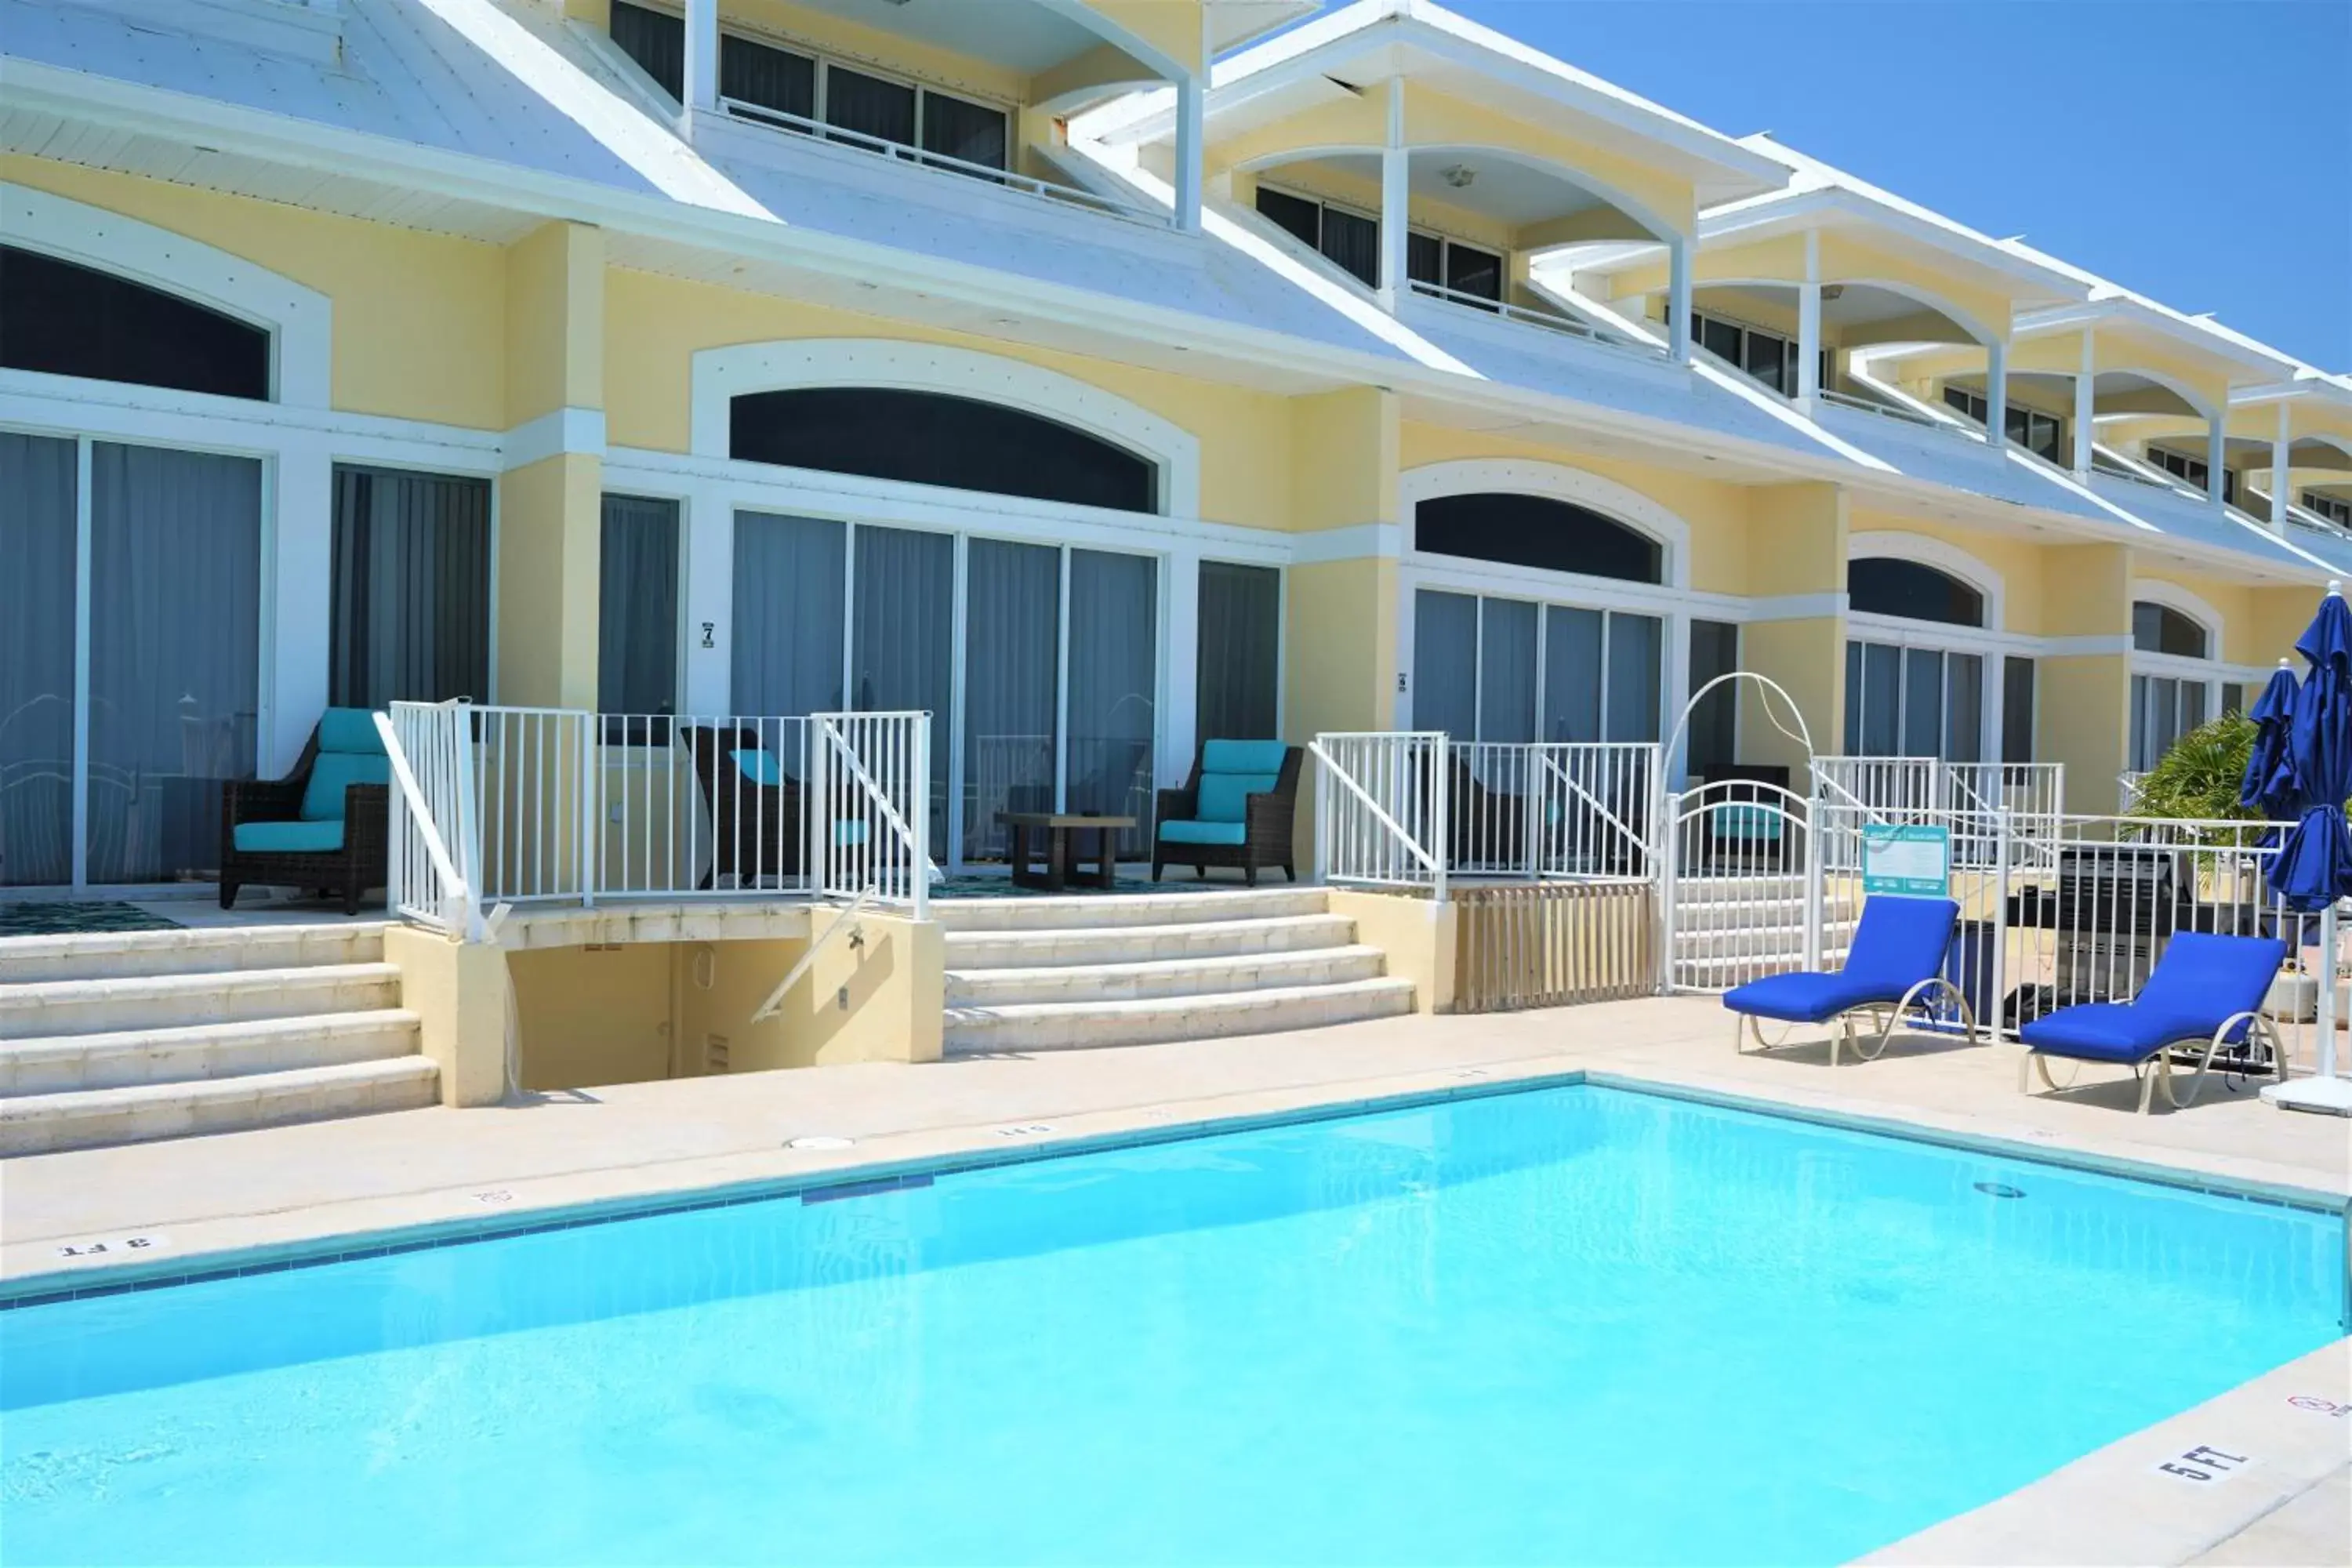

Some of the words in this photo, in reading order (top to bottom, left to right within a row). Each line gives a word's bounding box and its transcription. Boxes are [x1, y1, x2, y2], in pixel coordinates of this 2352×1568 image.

[703, 628, 713, 640] 7
[126, 1237, 151, 1248] 3
[62, 1243, 108, 1257] FT
[2182, 1445, 2249, 1471] FT
[2158, 1462, 2212, 1481] 5
